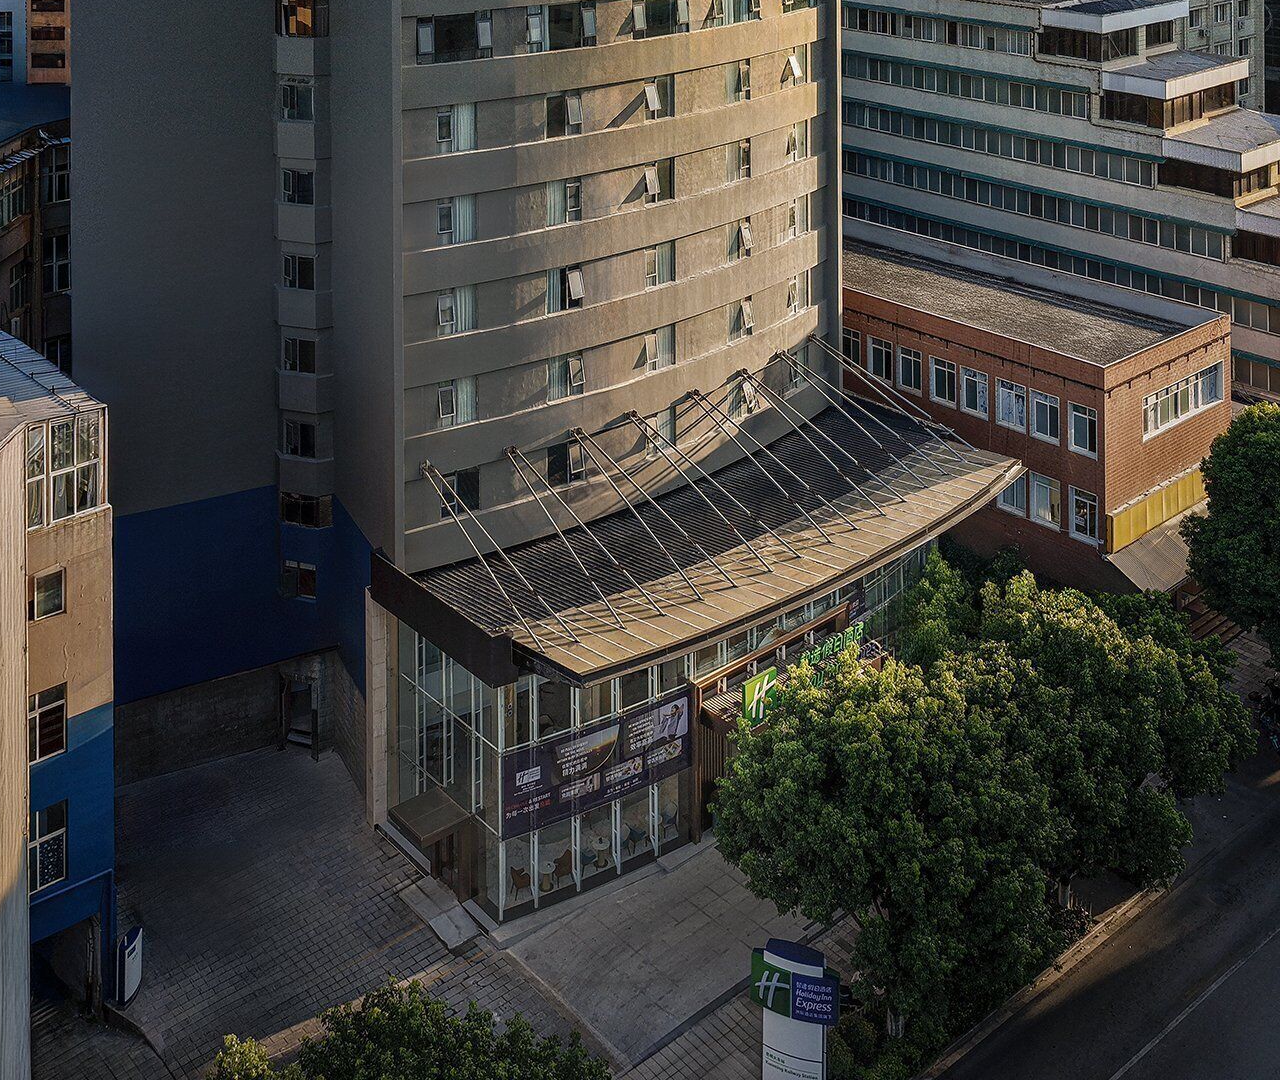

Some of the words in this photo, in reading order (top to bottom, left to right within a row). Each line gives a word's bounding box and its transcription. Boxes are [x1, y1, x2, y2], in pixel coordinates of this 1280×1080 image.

[795, 989, 821, 1001] Holiday
[821, 993, 832, 1001] Inn
[795, 998, 832, 1012] Express
[784, 1068, 801, 1078] Railway
